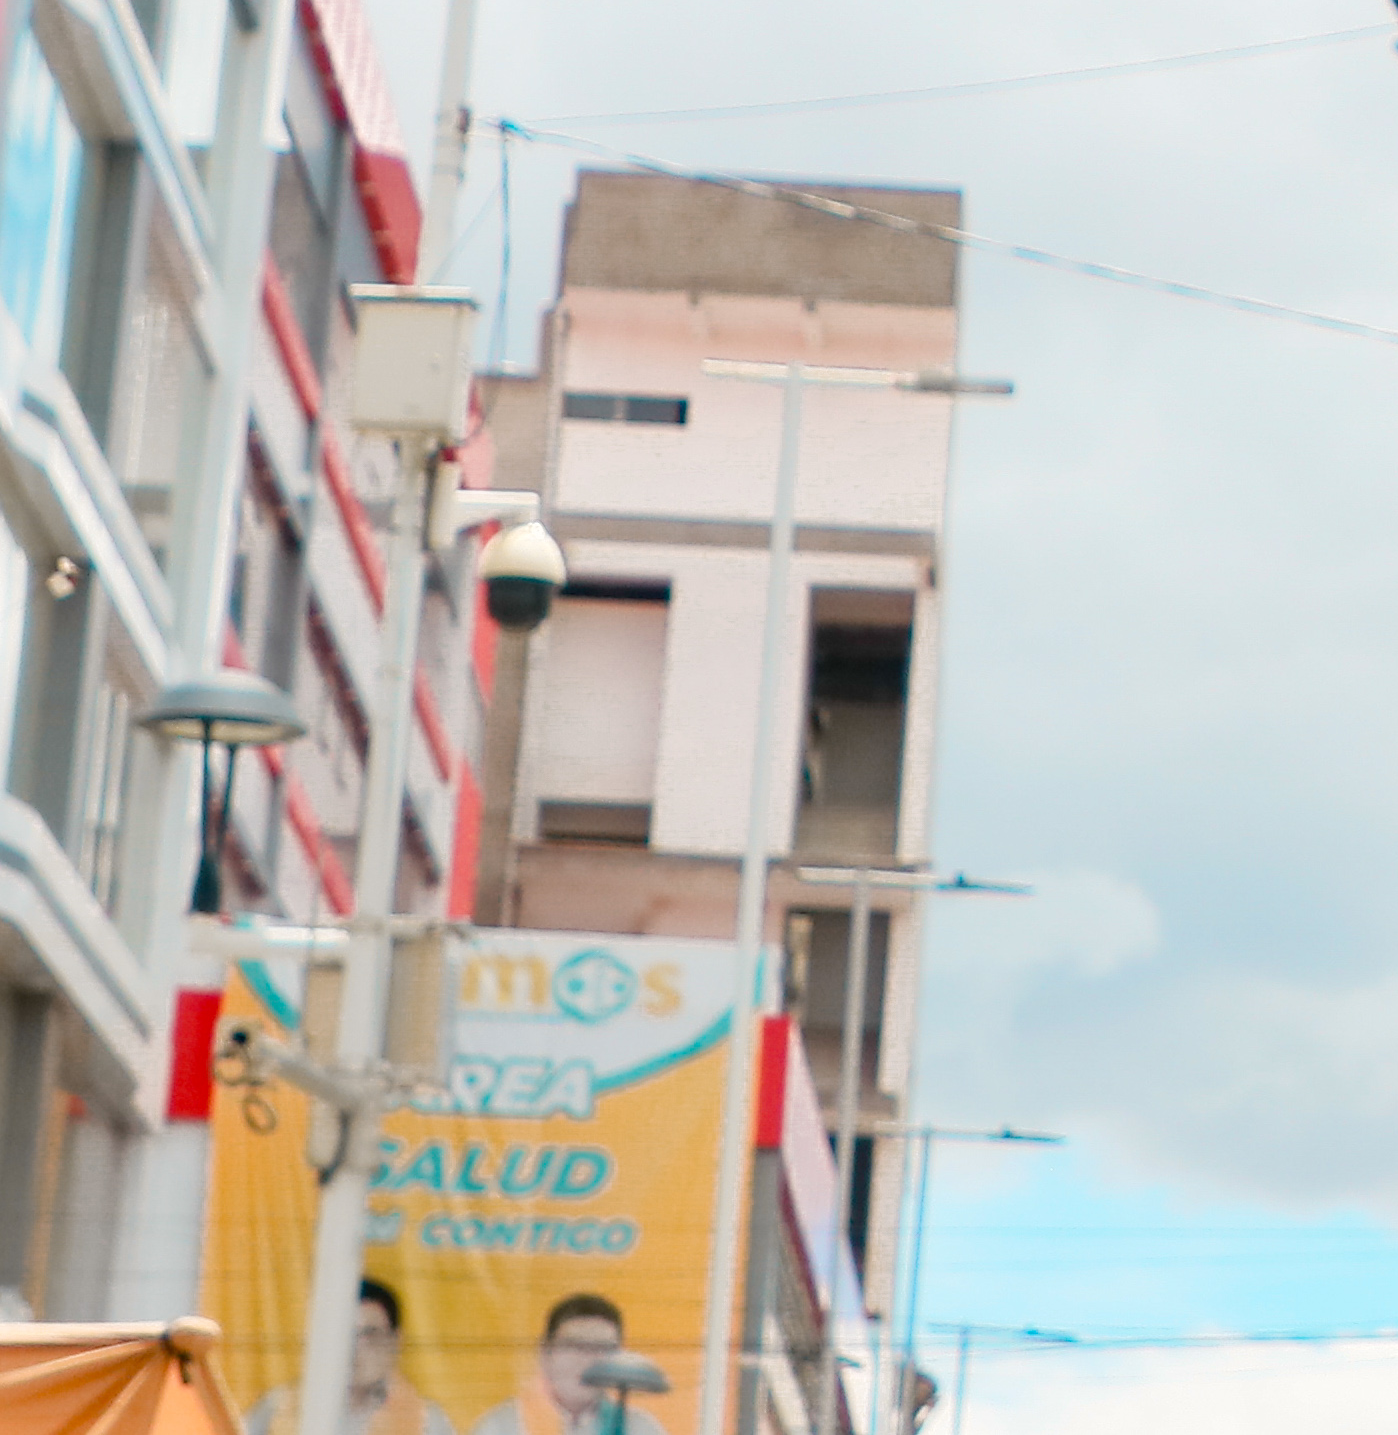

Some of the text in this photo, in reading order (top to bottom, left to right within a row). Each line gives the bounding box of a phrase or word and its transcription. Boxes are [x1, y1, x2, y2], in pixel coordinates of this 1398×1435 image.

[460, 949, 681, 1024] mos
[405, 1055, 596, 1120] REA
[420, 1216, 635, 1253] CONTIGO
